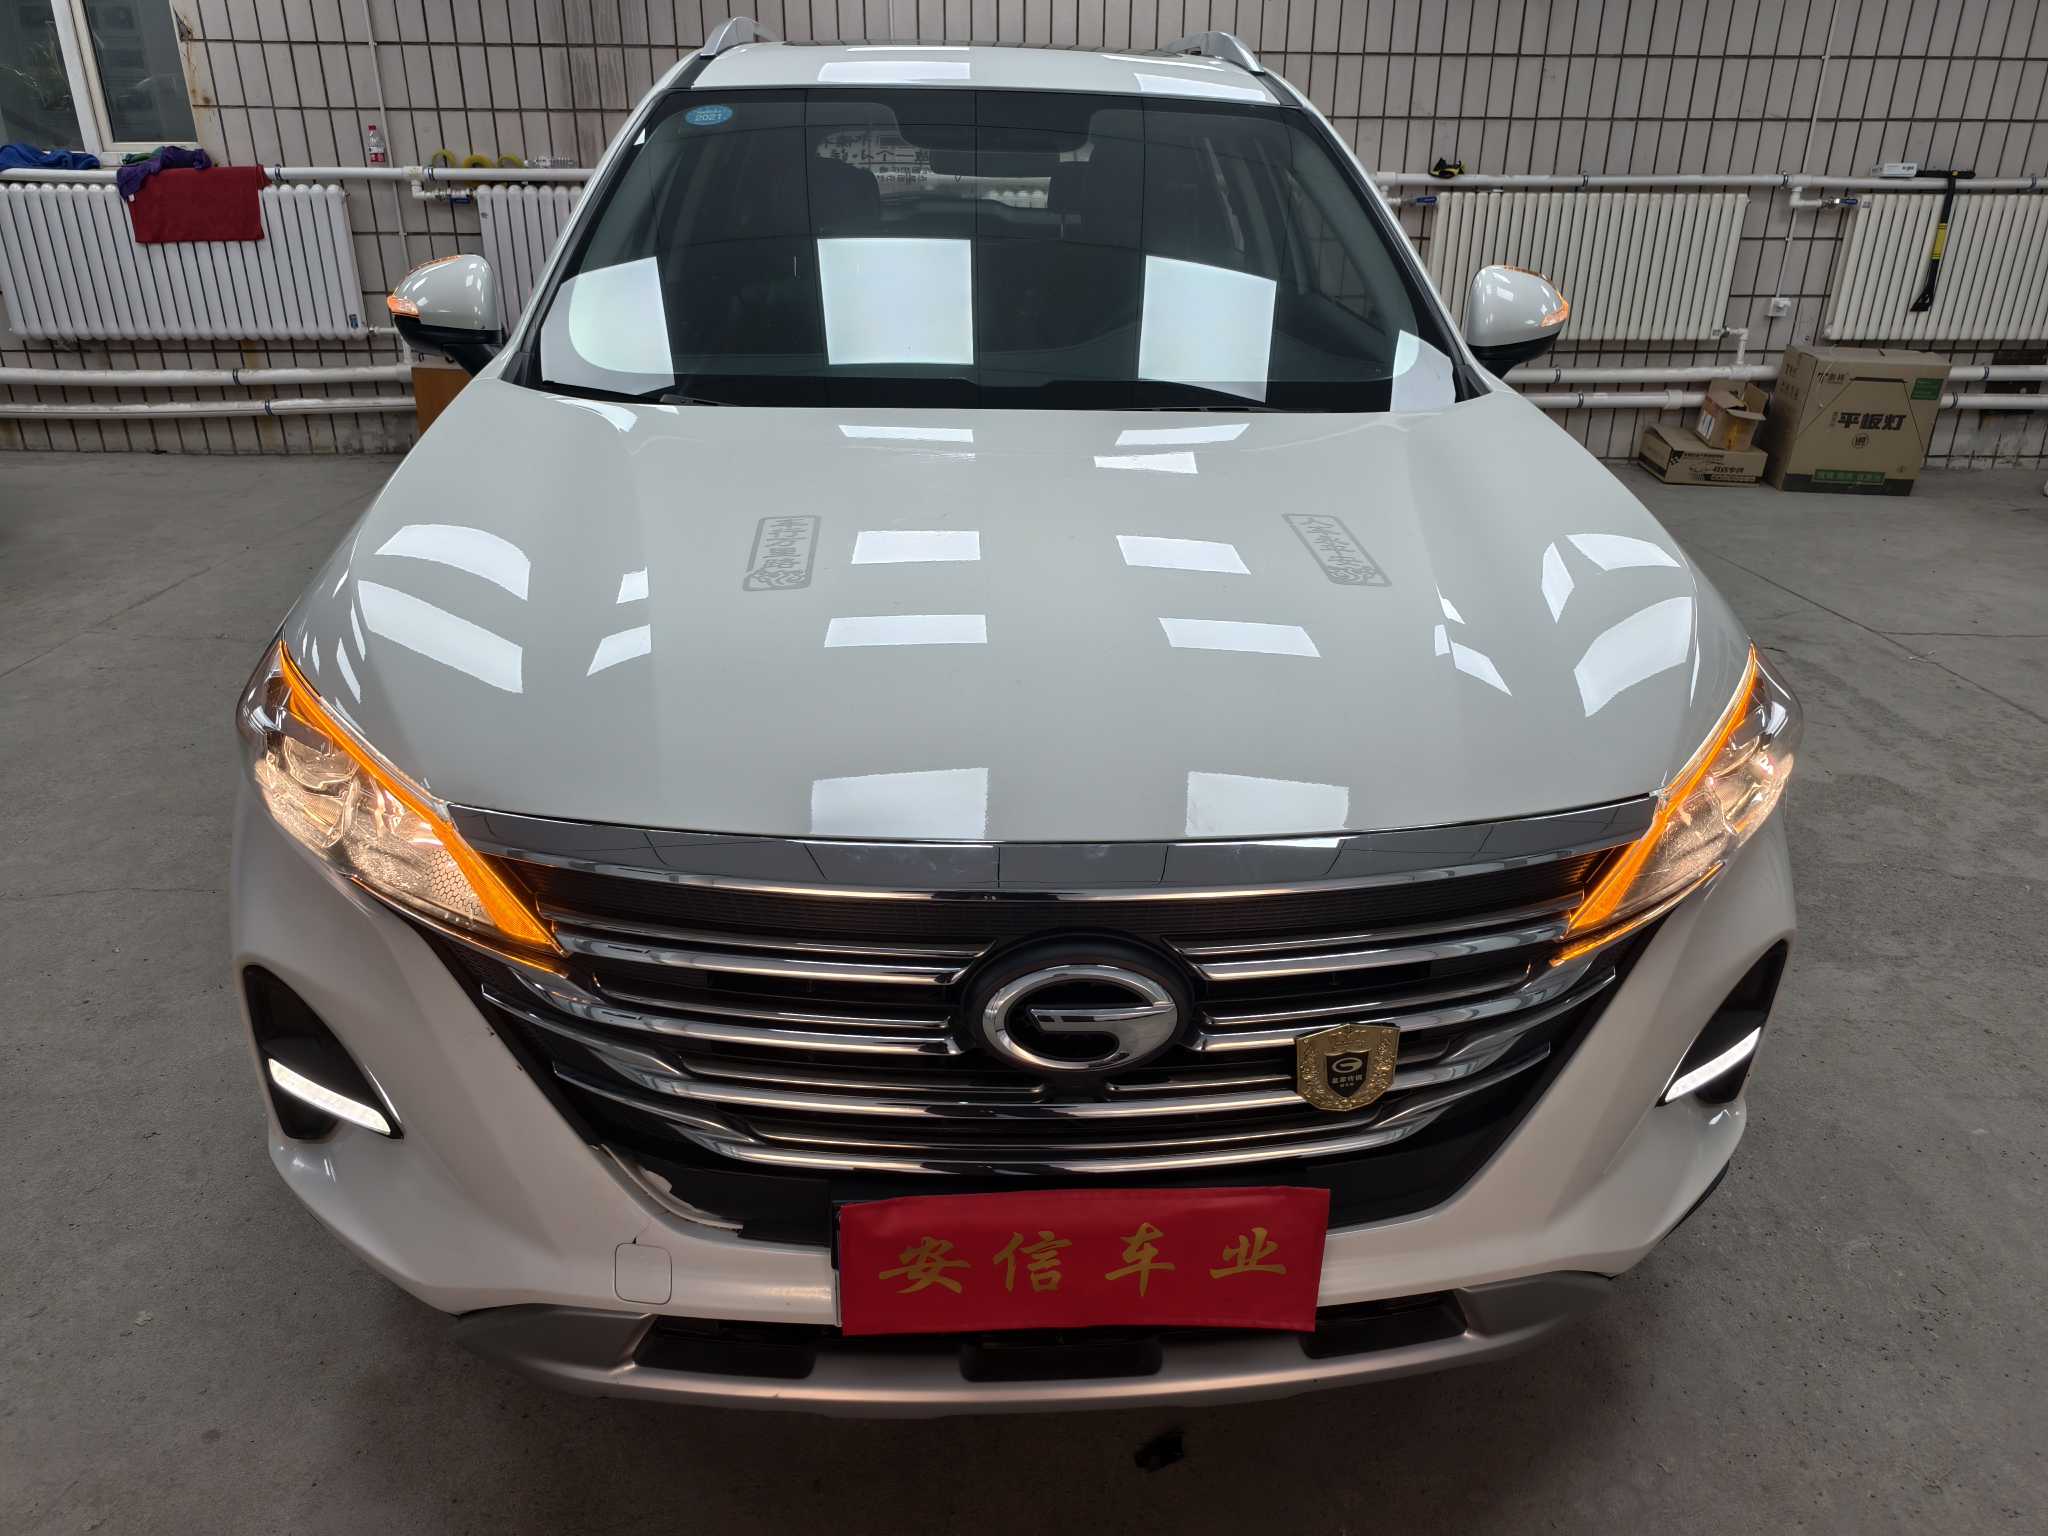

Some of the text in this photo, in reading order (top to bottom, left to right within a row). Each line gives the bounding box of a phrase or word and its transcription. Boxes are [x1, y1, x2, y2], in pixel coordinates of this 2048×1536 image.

[695, 111, 723, 122] 2021
[1838, 412, 1907, 431] 平板灯
[877, 1222, 1288, 1297] 安信车业
